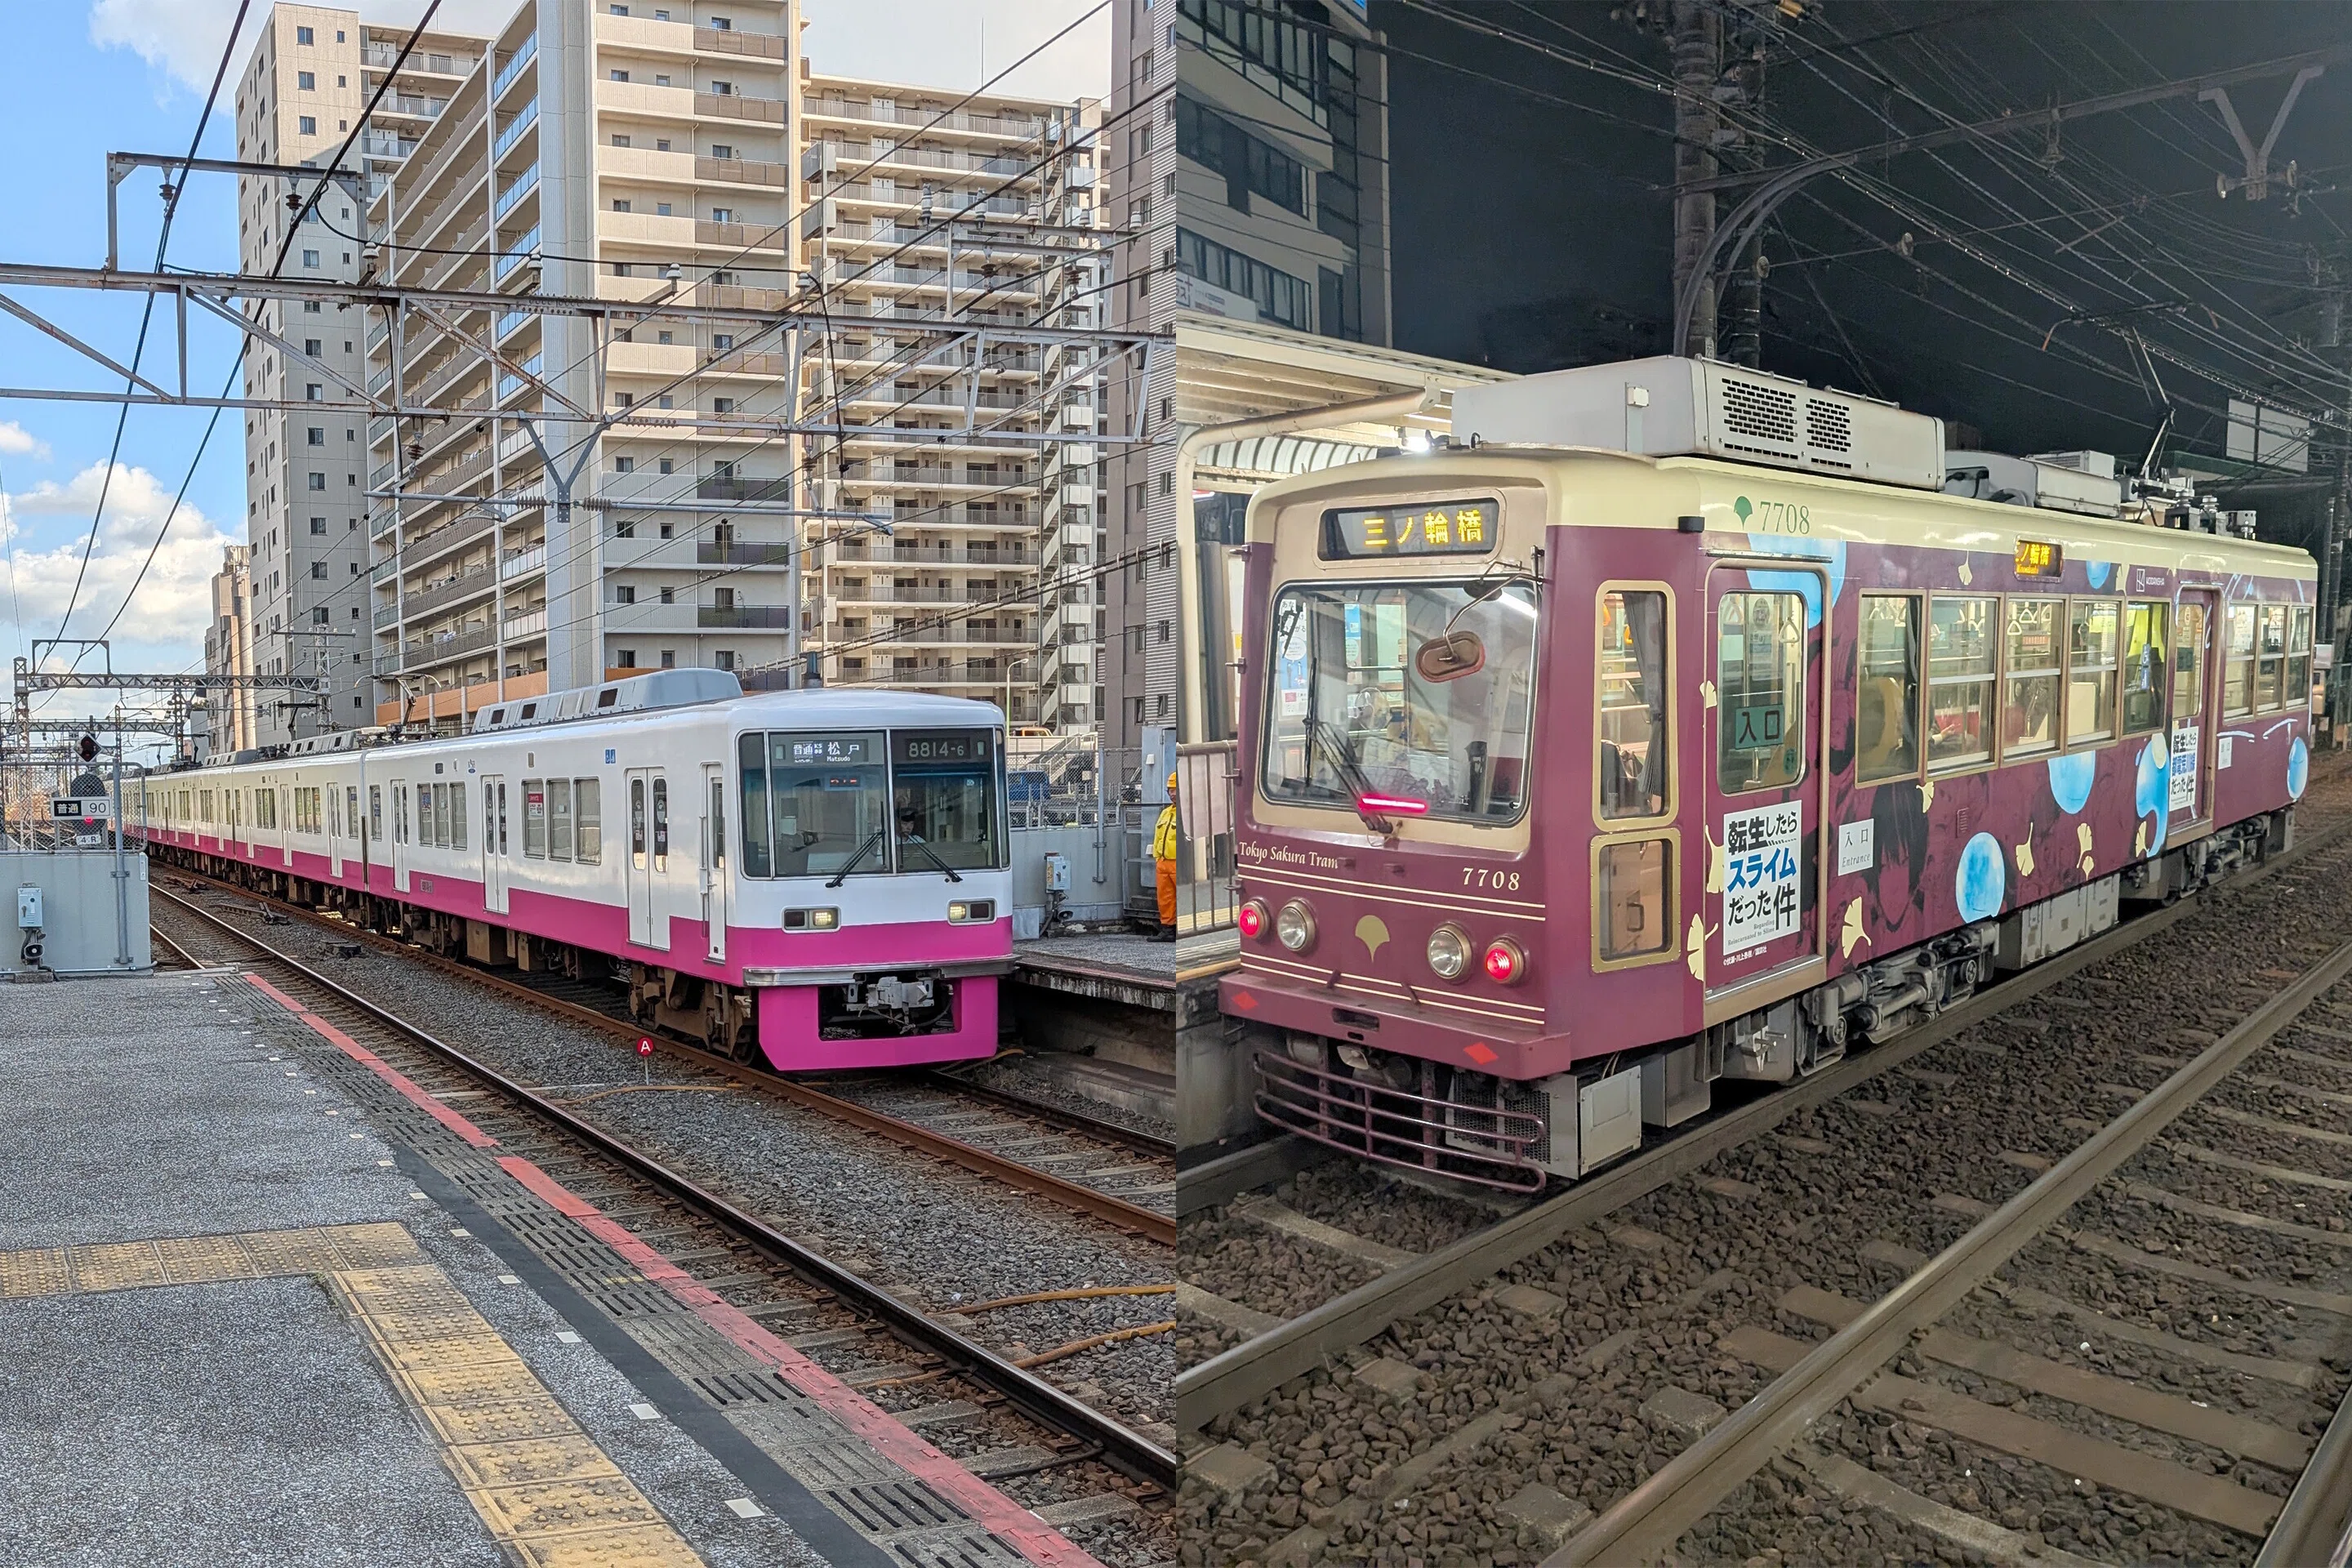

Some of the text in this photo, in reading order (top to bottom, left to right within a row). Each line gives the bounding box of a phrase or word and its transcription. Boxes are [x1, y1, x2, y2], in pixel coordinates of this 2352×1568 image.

[1363, 510, 1482, 544] 三ノ輪橋
[1759, 501, 1811, 535] 7708
[1739, 710, 1780, 744] 入口
[794, 744, 813, 755] 普通
[827, 741, 860, 755] 松戸
[908, 741, 964, 758] 8814-6
[56, 802, 106, 814] 普通 90
[1727, 811, 1797, 856] 転生したら
[1844, 828, 1869, 849] 入口
[1239, 840, 1339, 869] Tokyo Sakura Tram
[1842, 853, 1870, 868] Entrance
[1463, 866, 1520, 891] 7708
[1726, 847, 1797, 893] スライム
[1727, 882, 1797, 931] だった件
[640, 1040, 651, 1053] A
